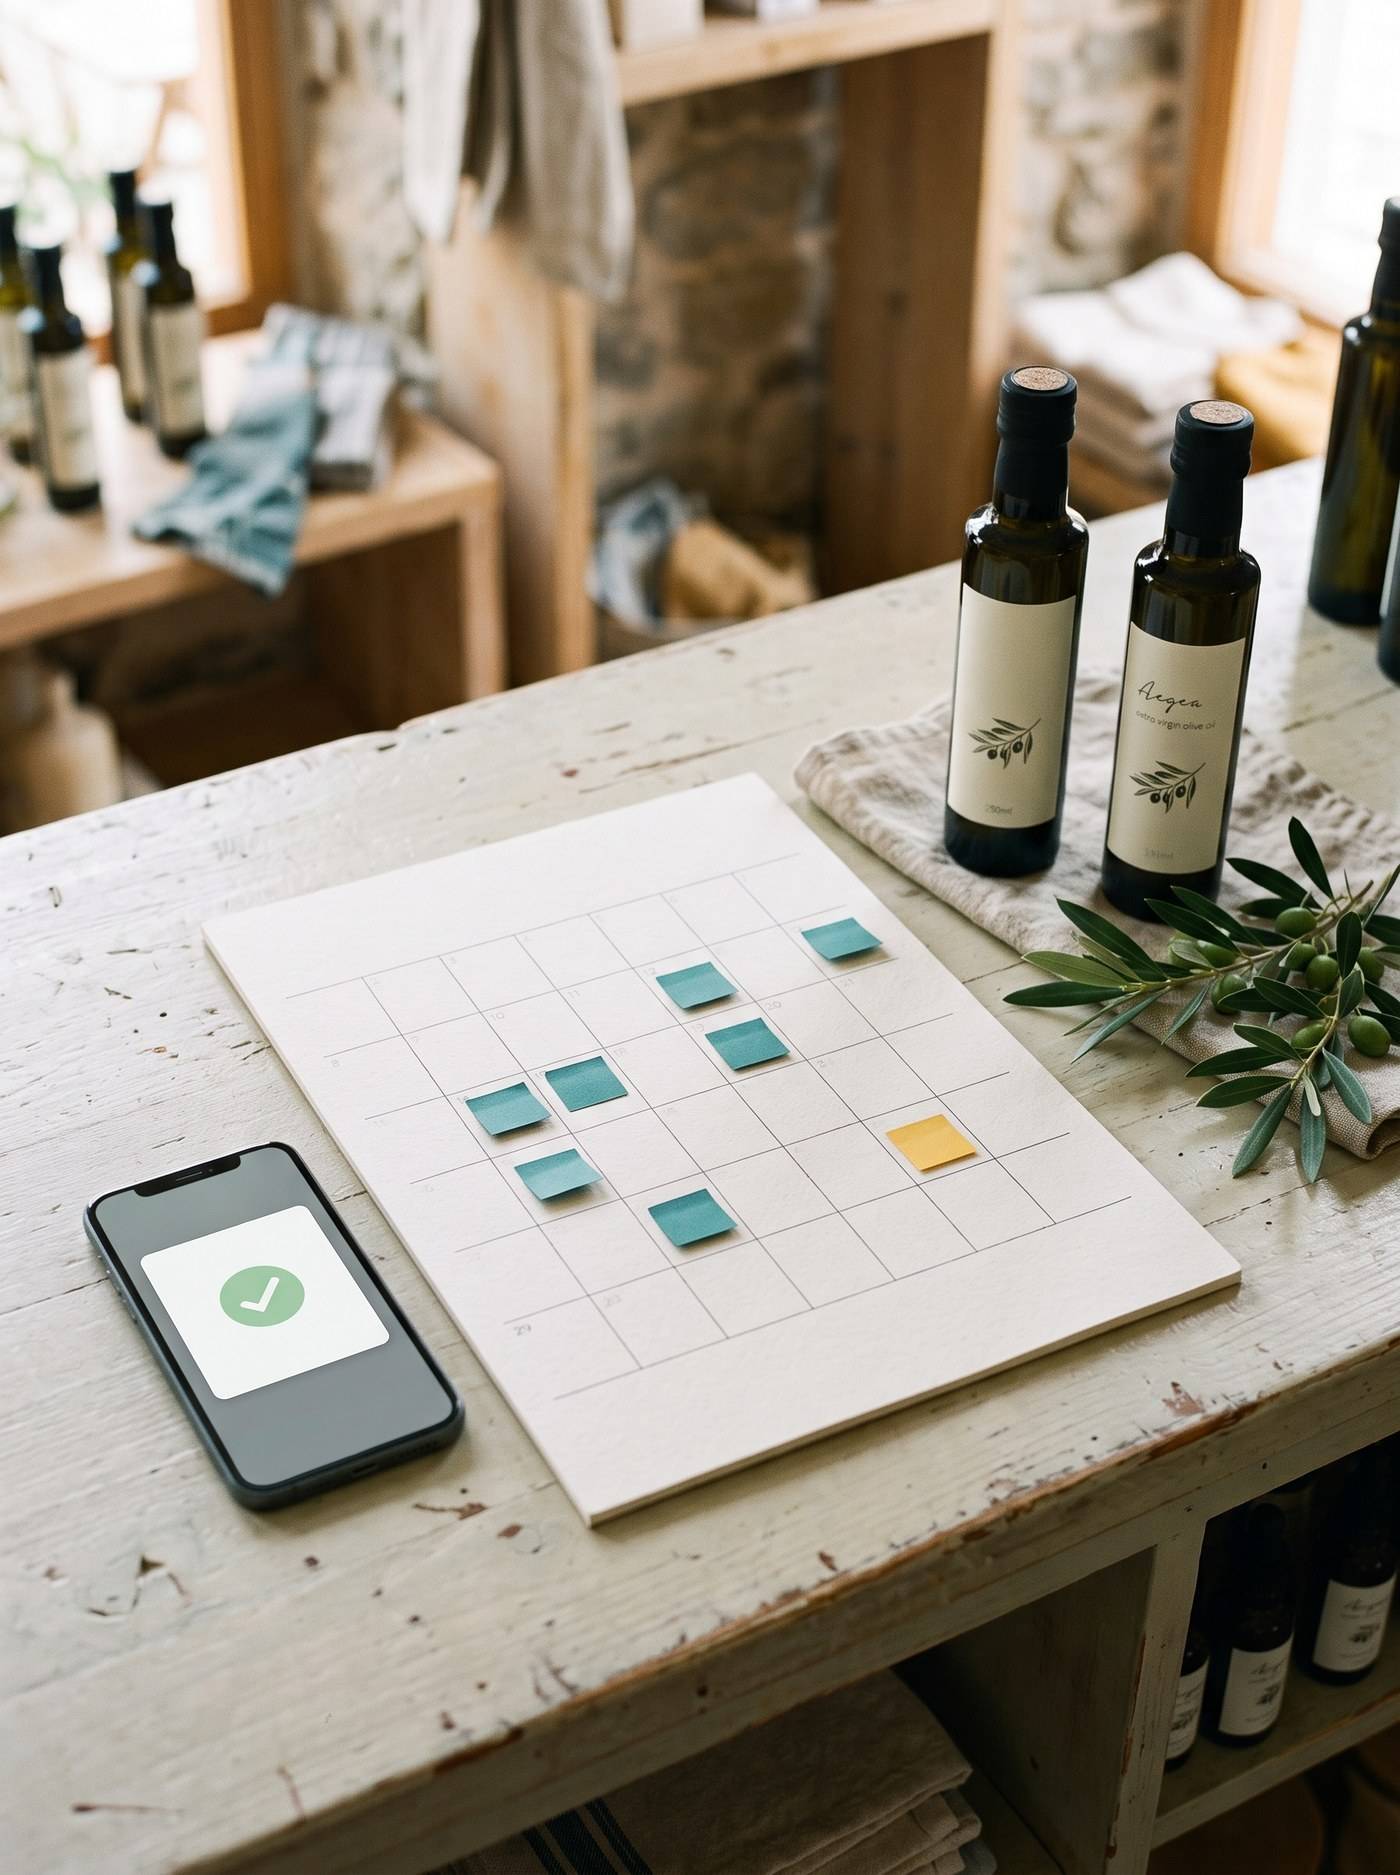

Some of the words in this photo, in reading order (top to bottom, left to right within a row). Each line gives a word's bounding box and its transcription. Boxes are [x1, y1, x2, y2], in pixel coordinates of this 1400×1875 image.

[1137, 680, 1203, 714] Aegea
[1156, 719, 1182, 731] virgin
[1182, 720, 1204, 731] olive
